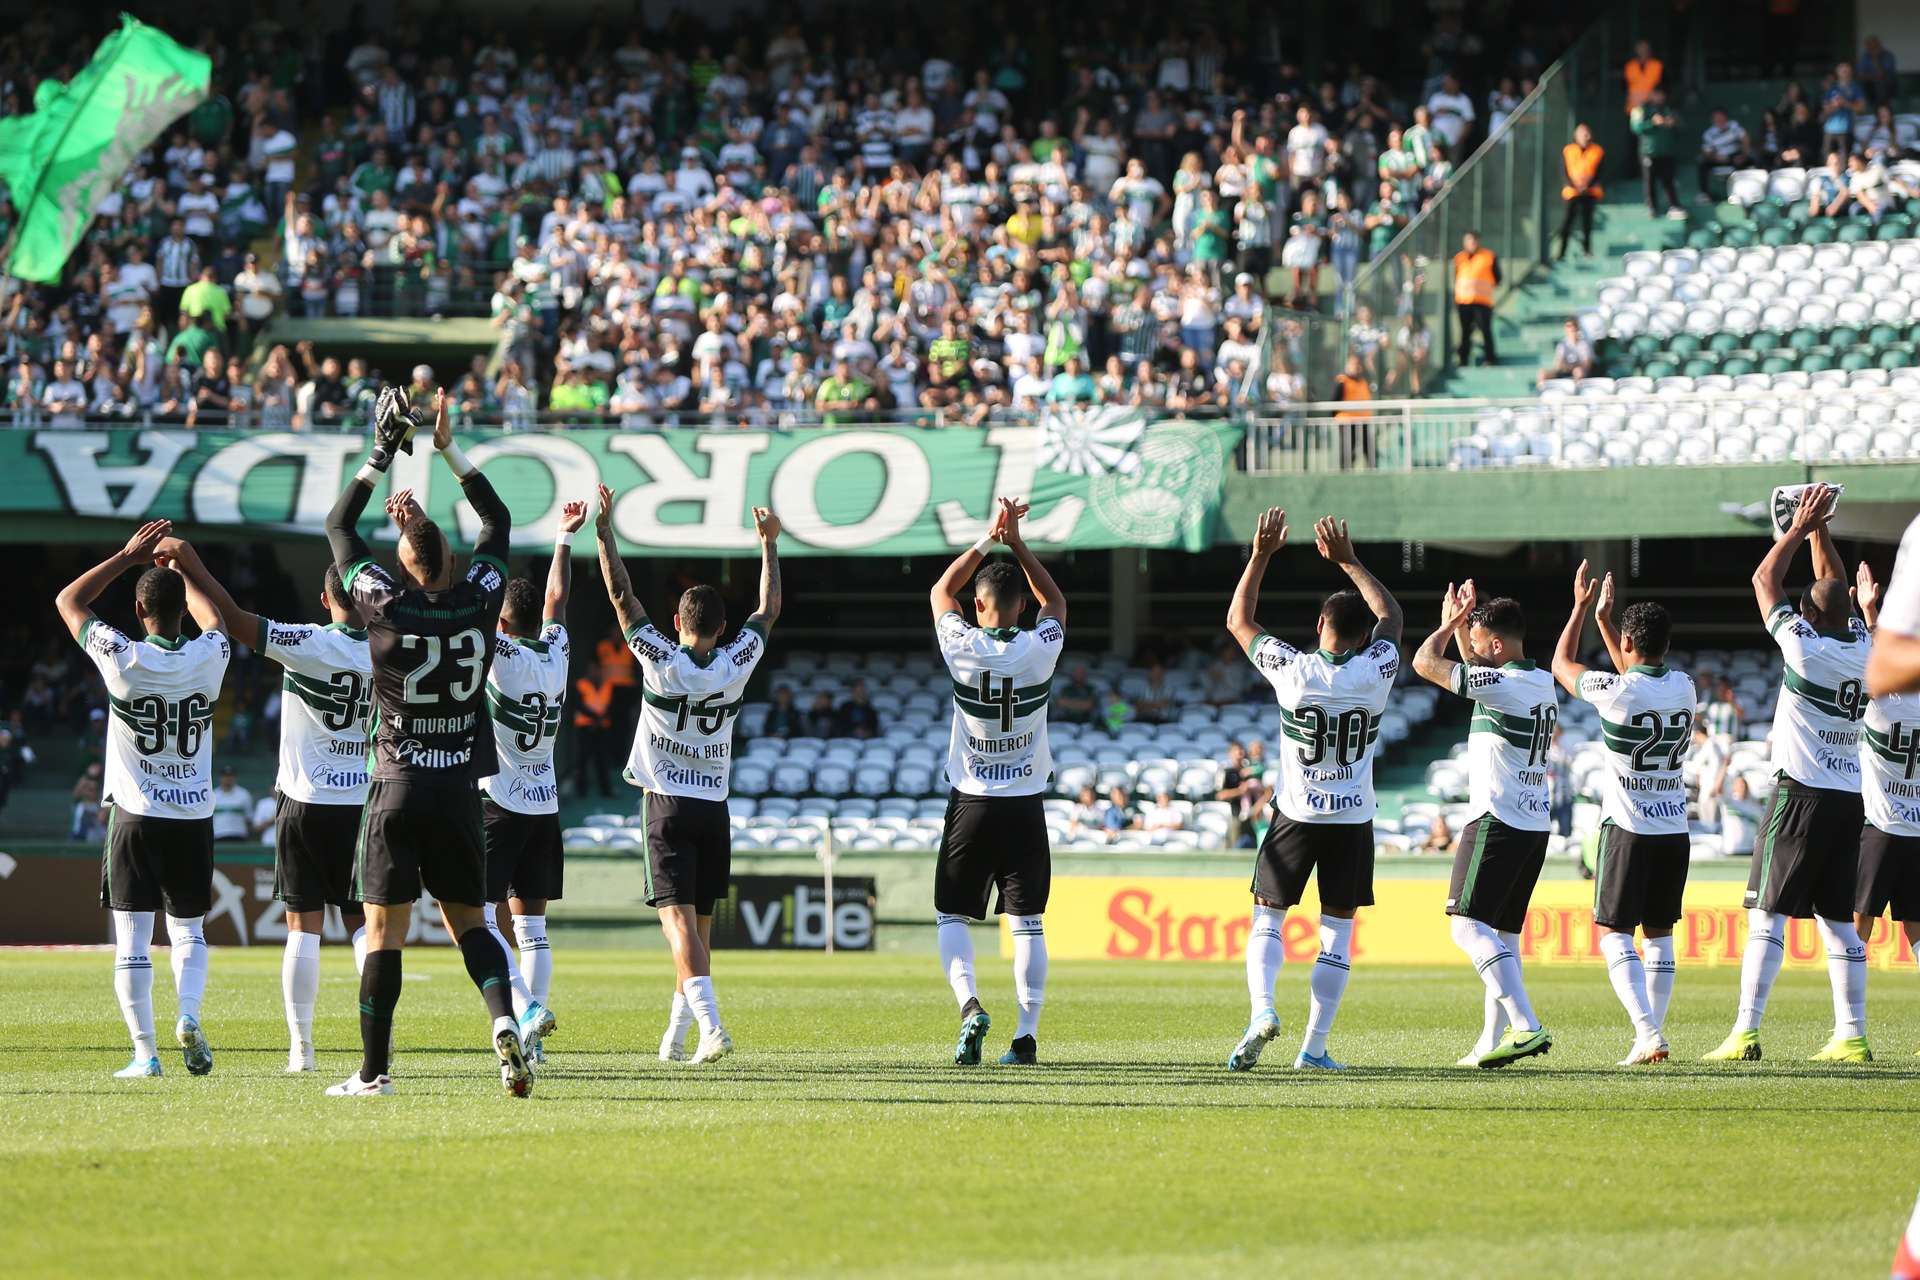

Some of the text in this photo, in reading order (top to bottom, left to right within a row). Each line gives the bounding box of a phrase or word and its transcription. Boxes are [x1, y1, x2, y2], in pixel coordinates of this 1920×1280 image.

[269, 635, 301, 647] TORK
[401, 627, 485, 703] 23
[131, 692, 209, 760] 36
[323, 669, 372, 736] 3
[979, 669, 1019, 733] 4
[1836, 678, 1862, 722] 9
[650, 733, 700, 759] PATRICK
[1293, 704, 1371, 768] 30
[1631, 708, 1692, 771] 22
[1106, 886, 1367, 961] Staret
[1845, 946, 1865, 955] CF
